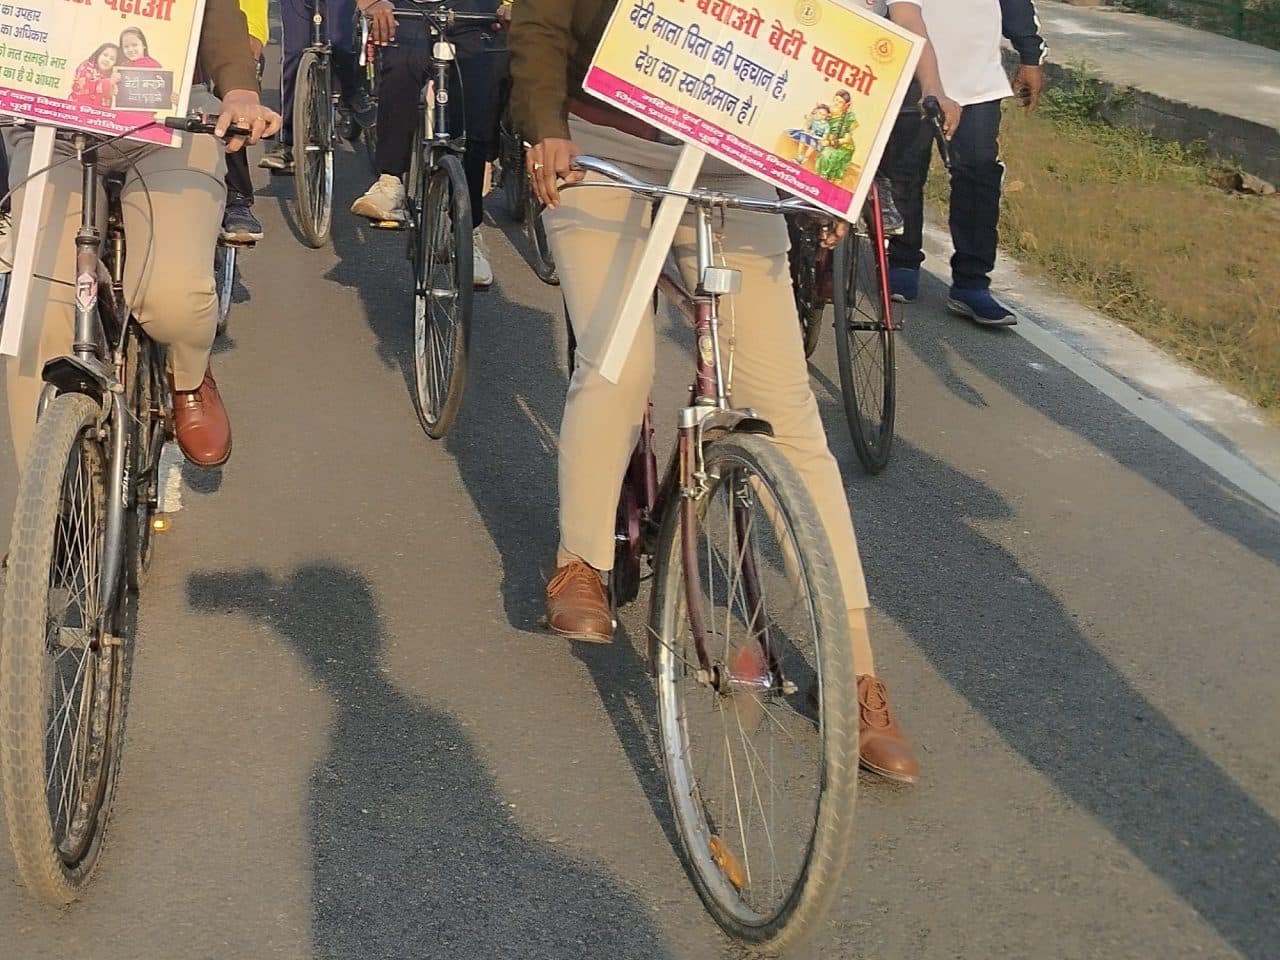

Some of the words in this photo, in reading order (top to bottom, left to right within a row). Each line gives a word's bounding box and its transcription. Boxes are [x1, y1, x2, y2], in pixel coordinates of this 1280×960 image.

[2, 4, 14, 16] का
[15, 7, 41, 22] उपहार
[0, 24, 12, 36] का
[14, 24, 48, 43] अधिकार
[7, 48, 22, 60] मत
[23, 51, 49, 66] समझो
[50, 56, 67, 69] भार
[652, 15, 684, 45] माता
[682, 24, 712, 60] पिता
[711, 41, 734, 69] की
[733, 55, 775, 91] पहचान
[768, 19, 807, 60] बेटी
[811, 46, 878, 96] पढ़ाओ
[3, 67, 15, 79] का
[17, 66, 25, 82] है
[25, 69, 34, 84] ये
[35, 73, 61, 88] आधार
[635, 44, 659, 77] देश
[658, 62, 680, 87] का
[678, 72, 740, 116] स्वाभिमान
